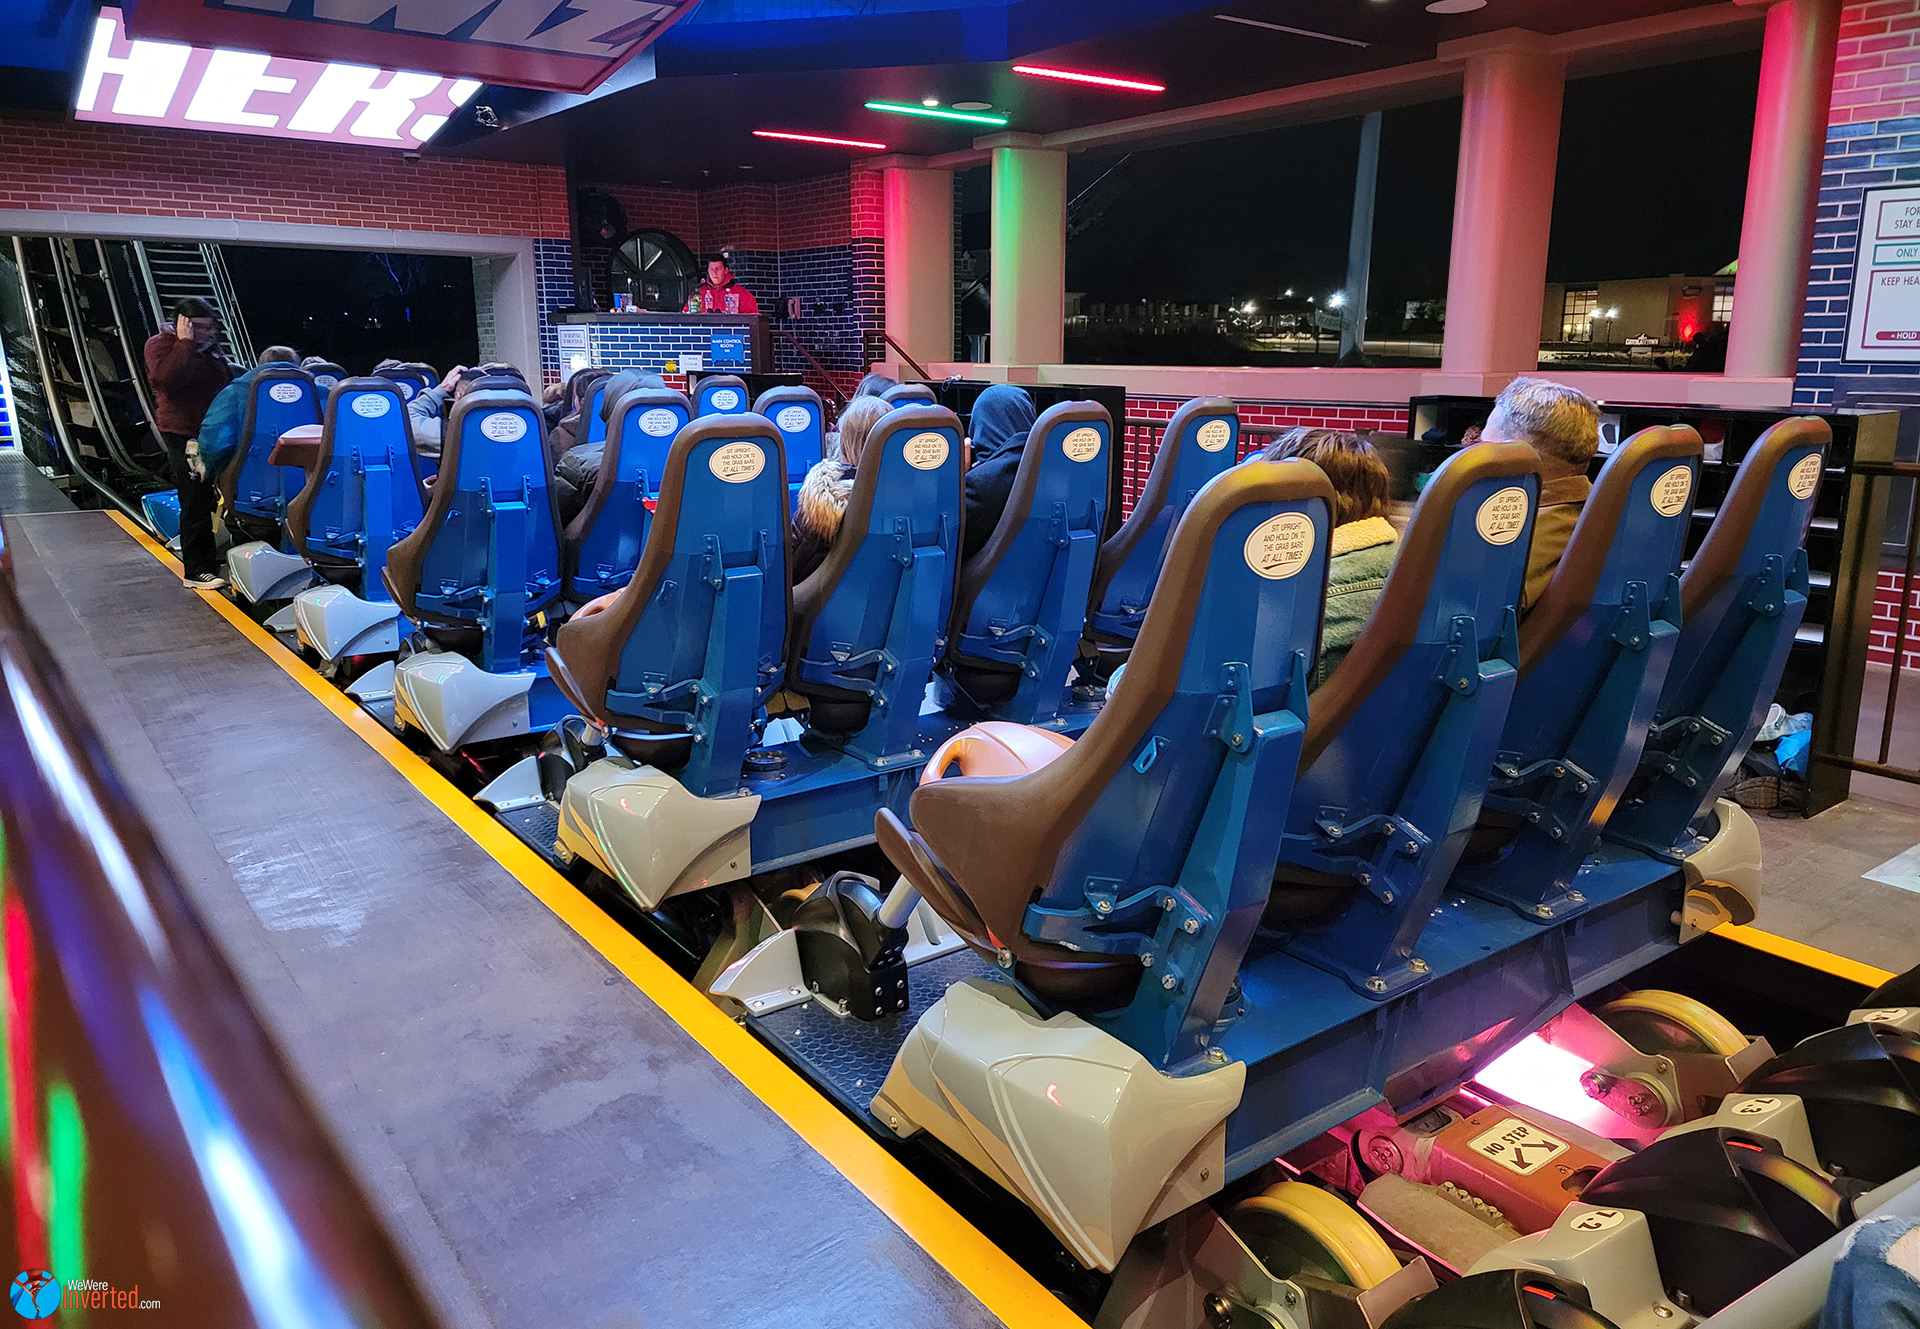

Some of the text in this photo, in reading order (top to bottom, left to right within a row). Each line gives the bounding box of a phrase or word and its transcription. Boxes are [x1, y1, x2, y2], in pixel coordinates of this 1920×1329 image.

[1894, 219, 1913, 229] STAY
[1896, 248, 1918, 258] ONLY
[1881, 276, 1901, 286] KEEP
[1896, 331, 1917, 340] HOLD
[1271, 522, 1302, 532] SIT UPRIGHT
[1276, 533, 1289, 541] HOLD
[1275, 543, 1289, 551] GRAB
[1291, 541, 1304, 549] BARS
[1261, 551, 1303, 563] AT ALL TIMES
[1483, 1127, 1530, 1155] NO STEP
